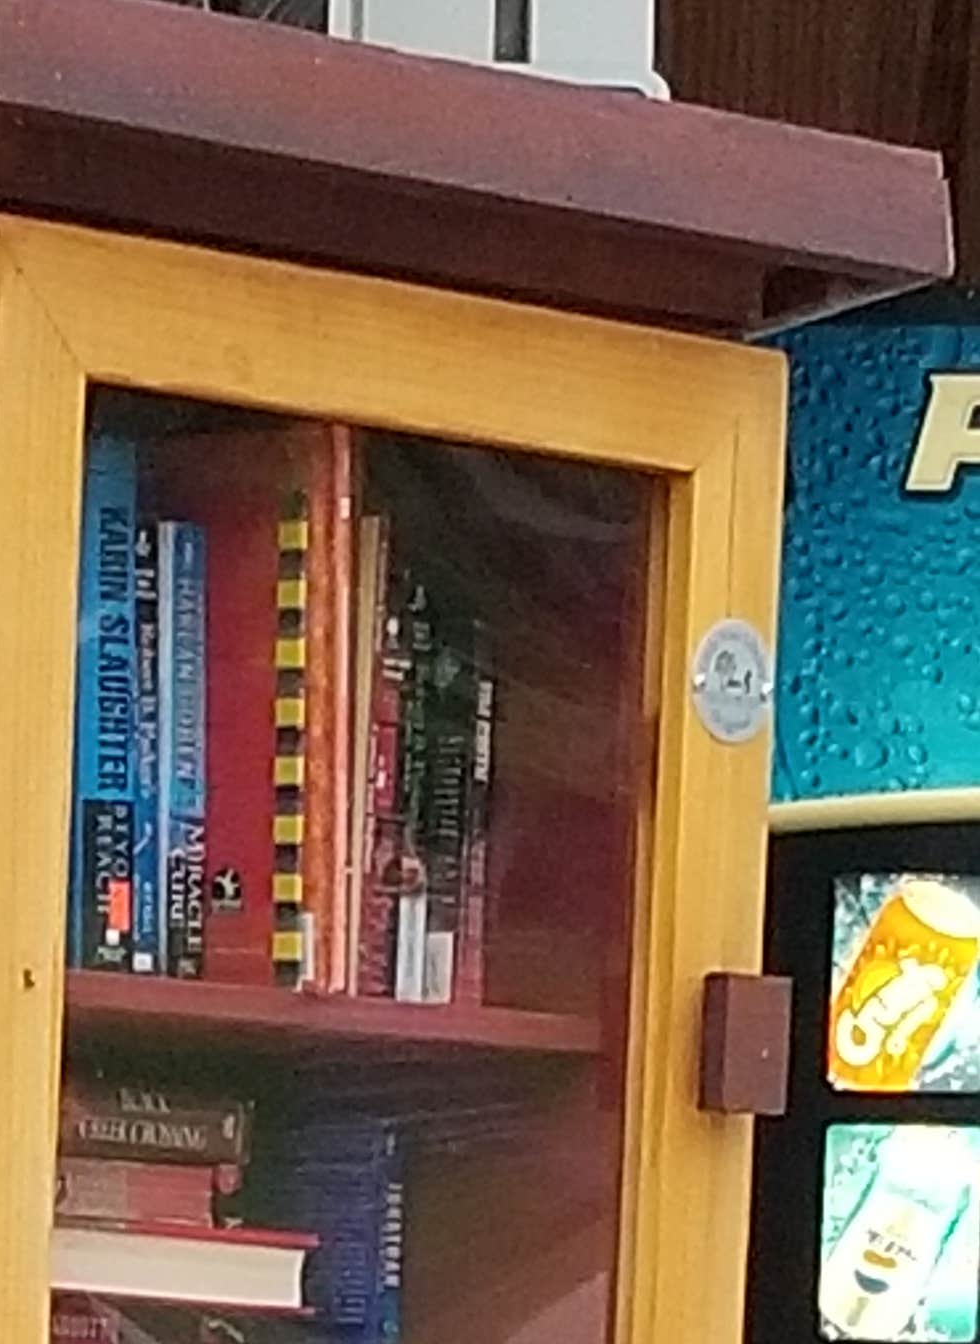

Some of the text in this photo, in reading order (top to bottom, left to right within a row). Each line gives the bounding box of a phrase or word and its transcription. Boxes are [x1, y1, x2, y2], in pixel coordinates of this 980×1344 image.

[97, 507, 131, 791] KARIN SLAUGHTER
[182, 822, 206, 953] MIRACLE
